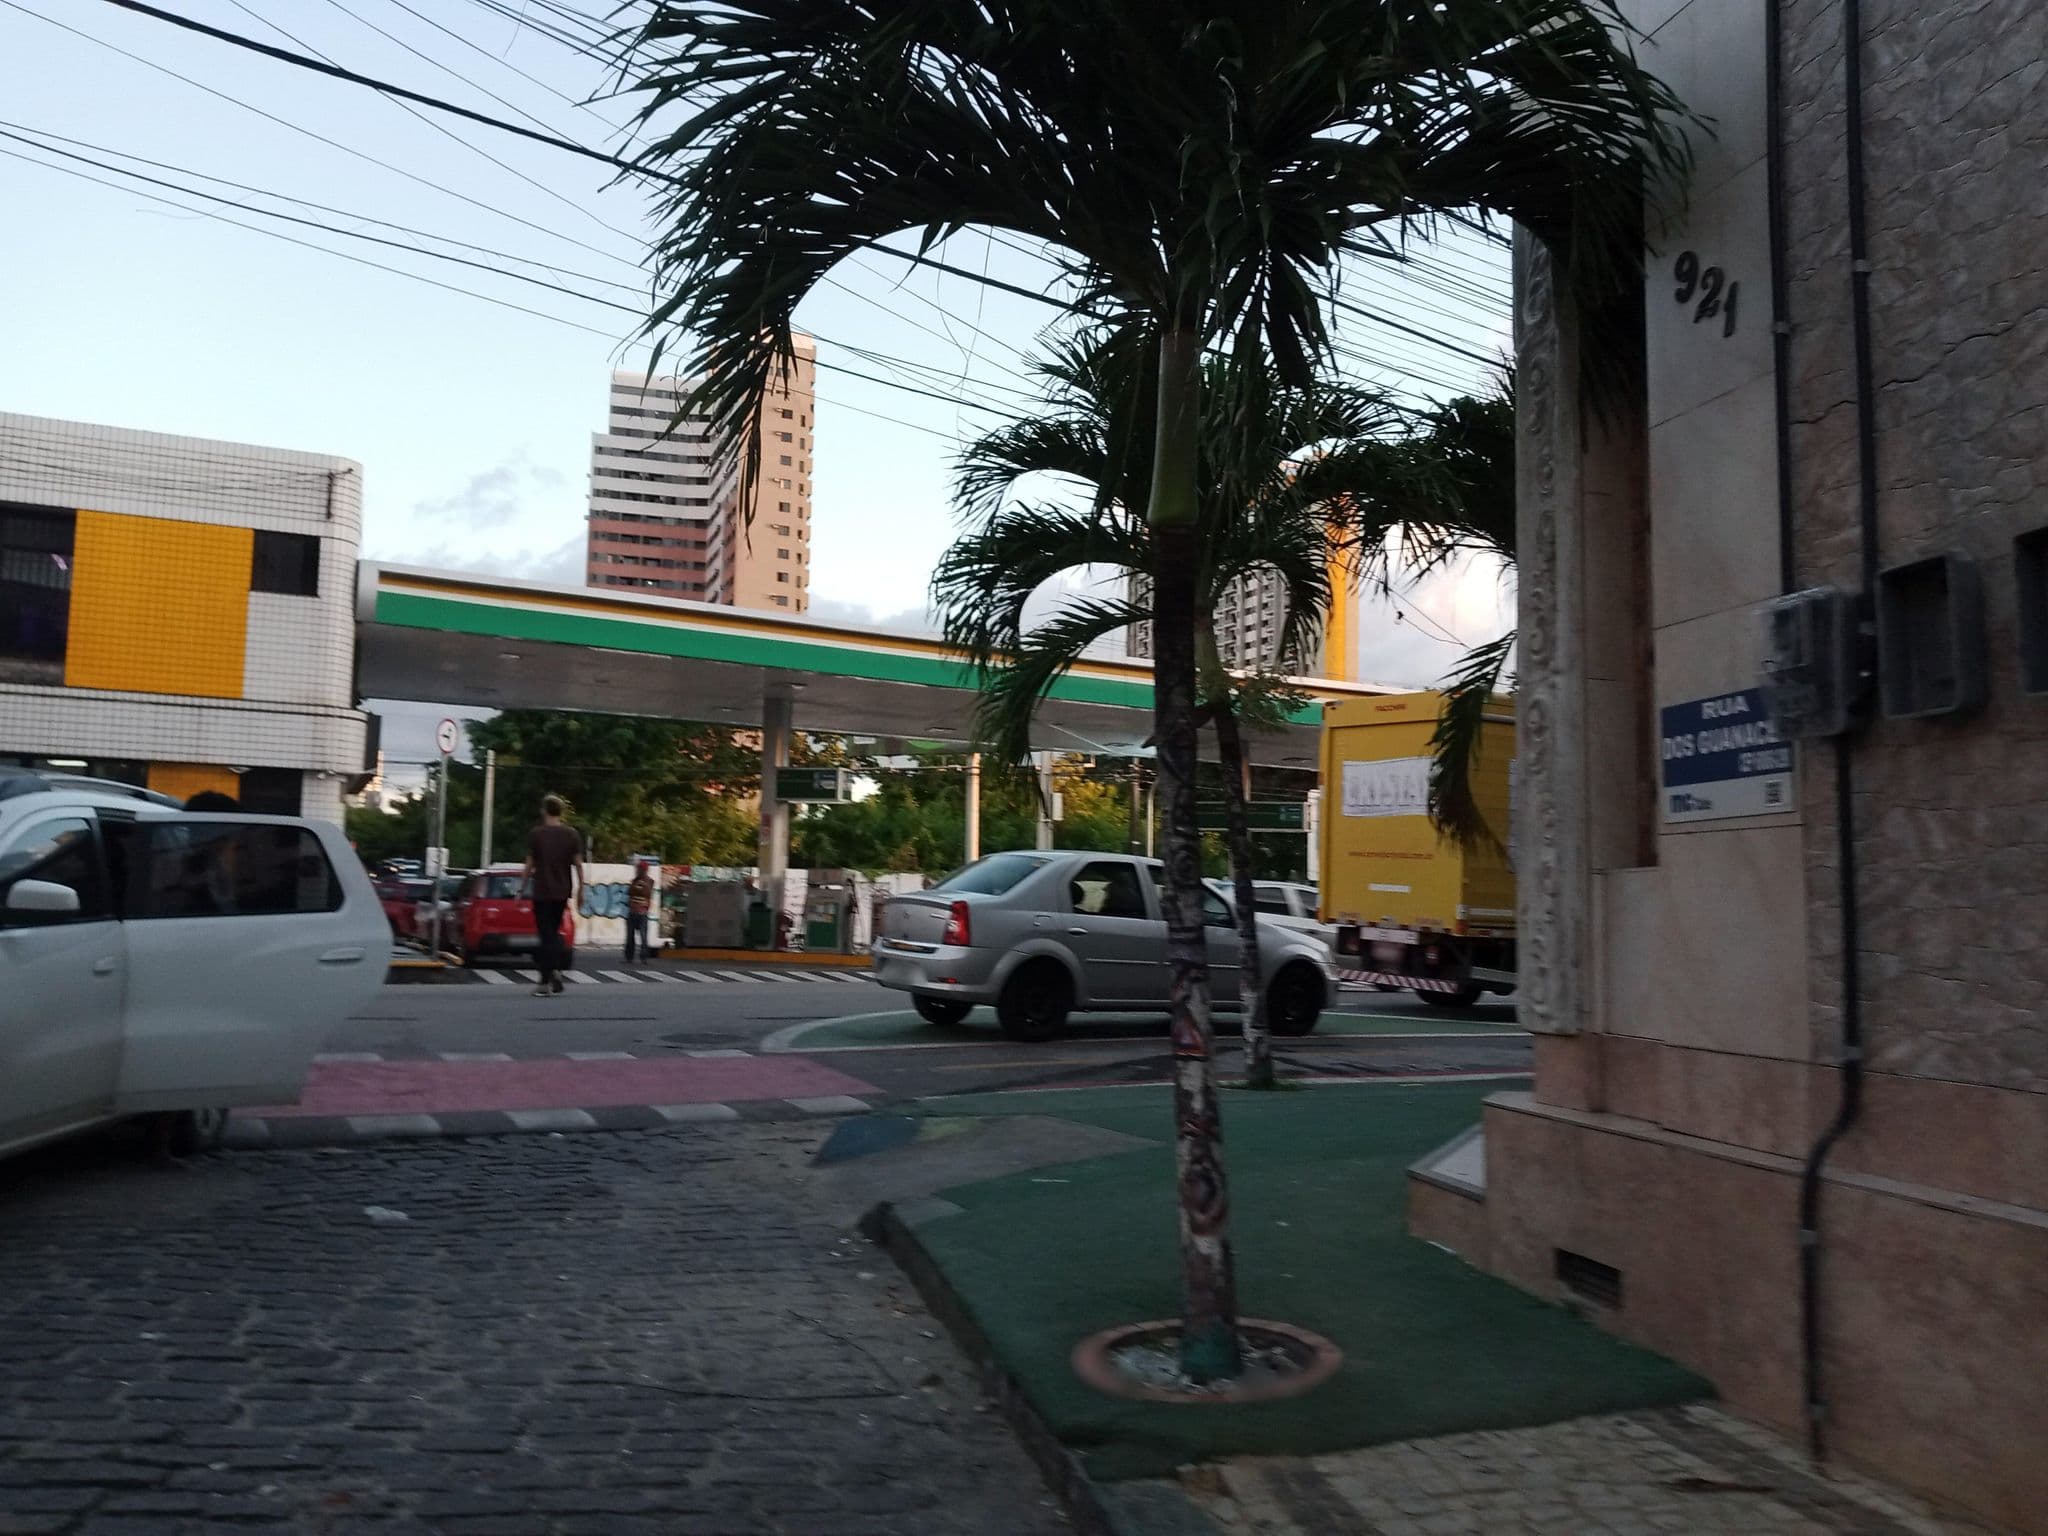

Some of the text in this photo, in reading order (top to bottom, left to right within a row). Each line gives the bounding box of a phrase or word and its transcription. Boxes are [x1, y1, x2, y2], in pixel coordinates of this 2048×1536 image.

[1674, 250, 1739, 338] 921
[1701, 695, 1750, 720] RUA
[1663, 733, 1695, 760] DOS
